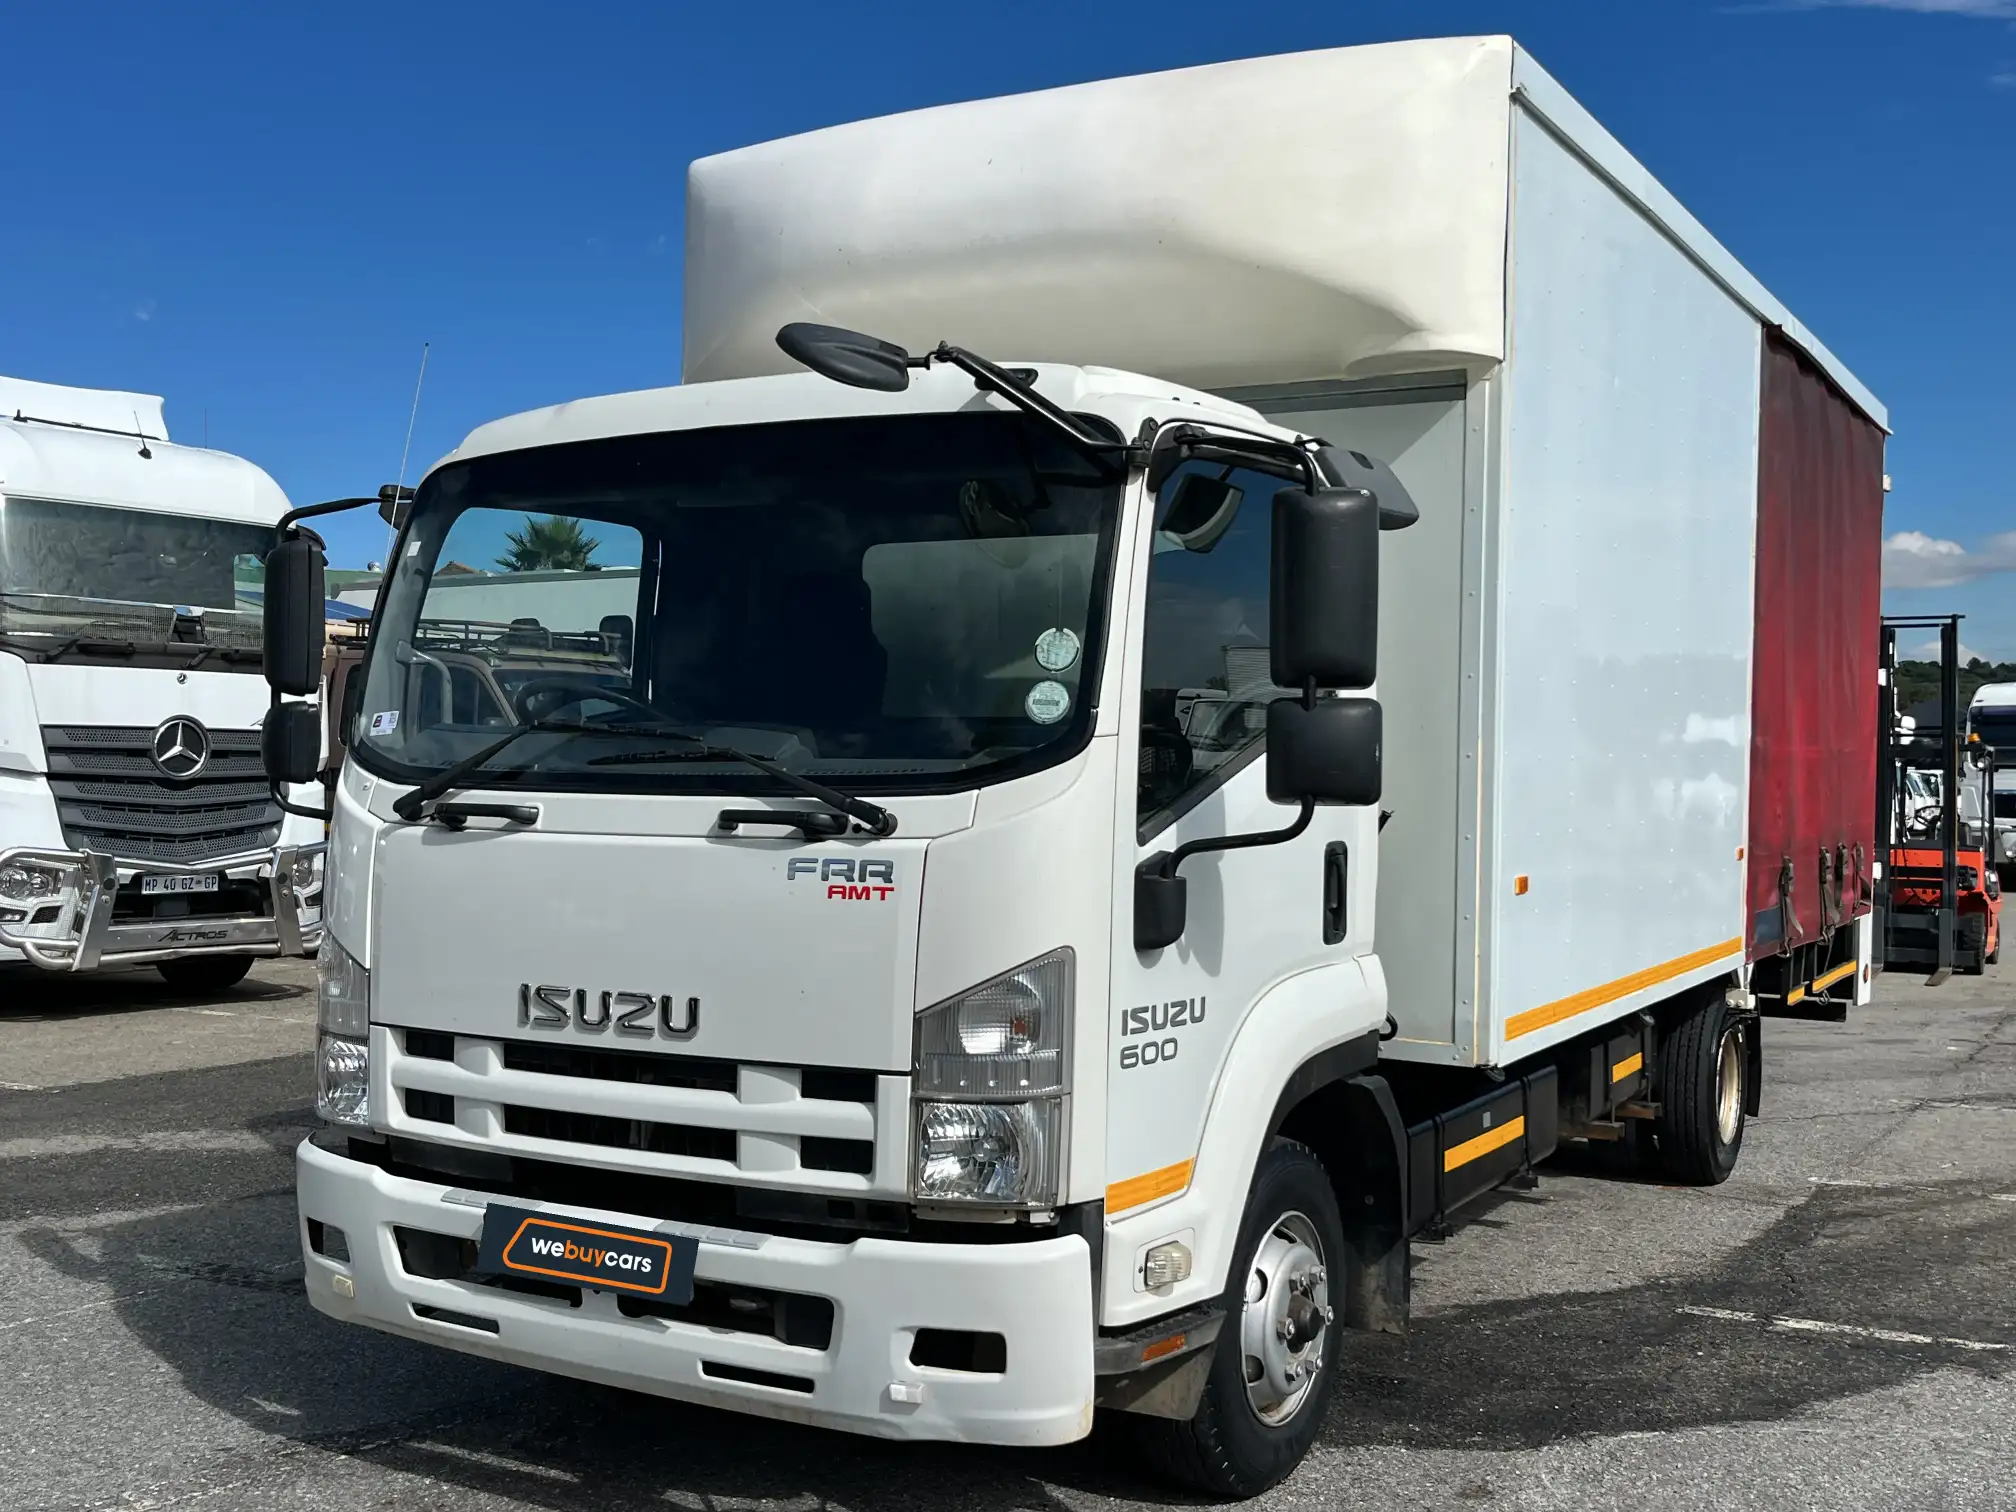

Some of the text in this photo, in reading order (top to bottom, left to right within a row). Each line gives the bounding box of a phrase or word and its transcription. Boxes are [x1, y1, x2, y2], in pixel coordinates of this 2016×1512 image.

[787, 857, 894, 883] FRR
[163, 878, 177, 891] 40
[181, 877, 195, 891] GZ
[204, 876, 218, 889] GP
[827, 884, 895, 901] AMT
[158, 929, 228, 942] ACTROS
[517, 982, 701, 1042] ISUZU
[1121, 996, 1206, 1036] ISUZU
[1120, 1037, 1178, 1069] 600
